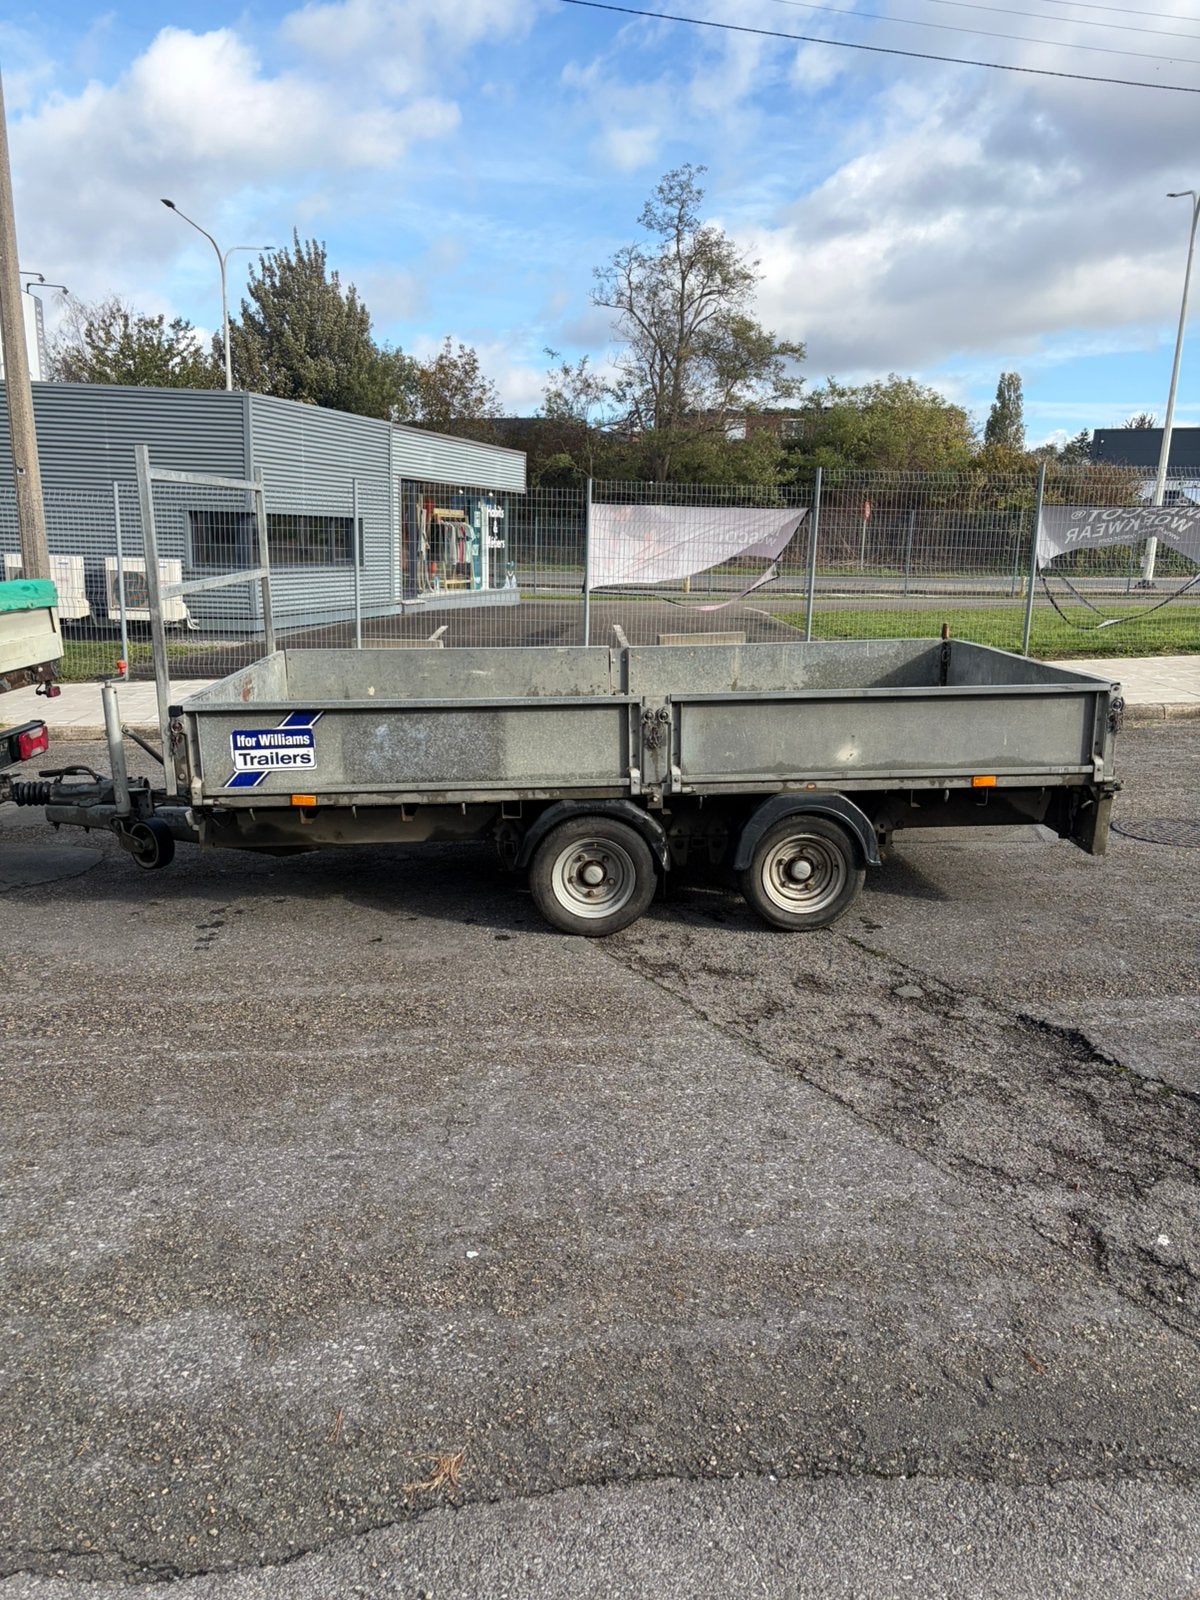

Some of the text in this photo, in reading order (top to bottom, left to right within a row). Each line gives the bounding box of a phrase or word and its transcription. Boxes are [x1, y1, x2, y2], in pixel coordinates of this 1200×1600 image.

[236, 733, 310, 747] Ifor Williams
[238, 751, 312, 767] Trailers
